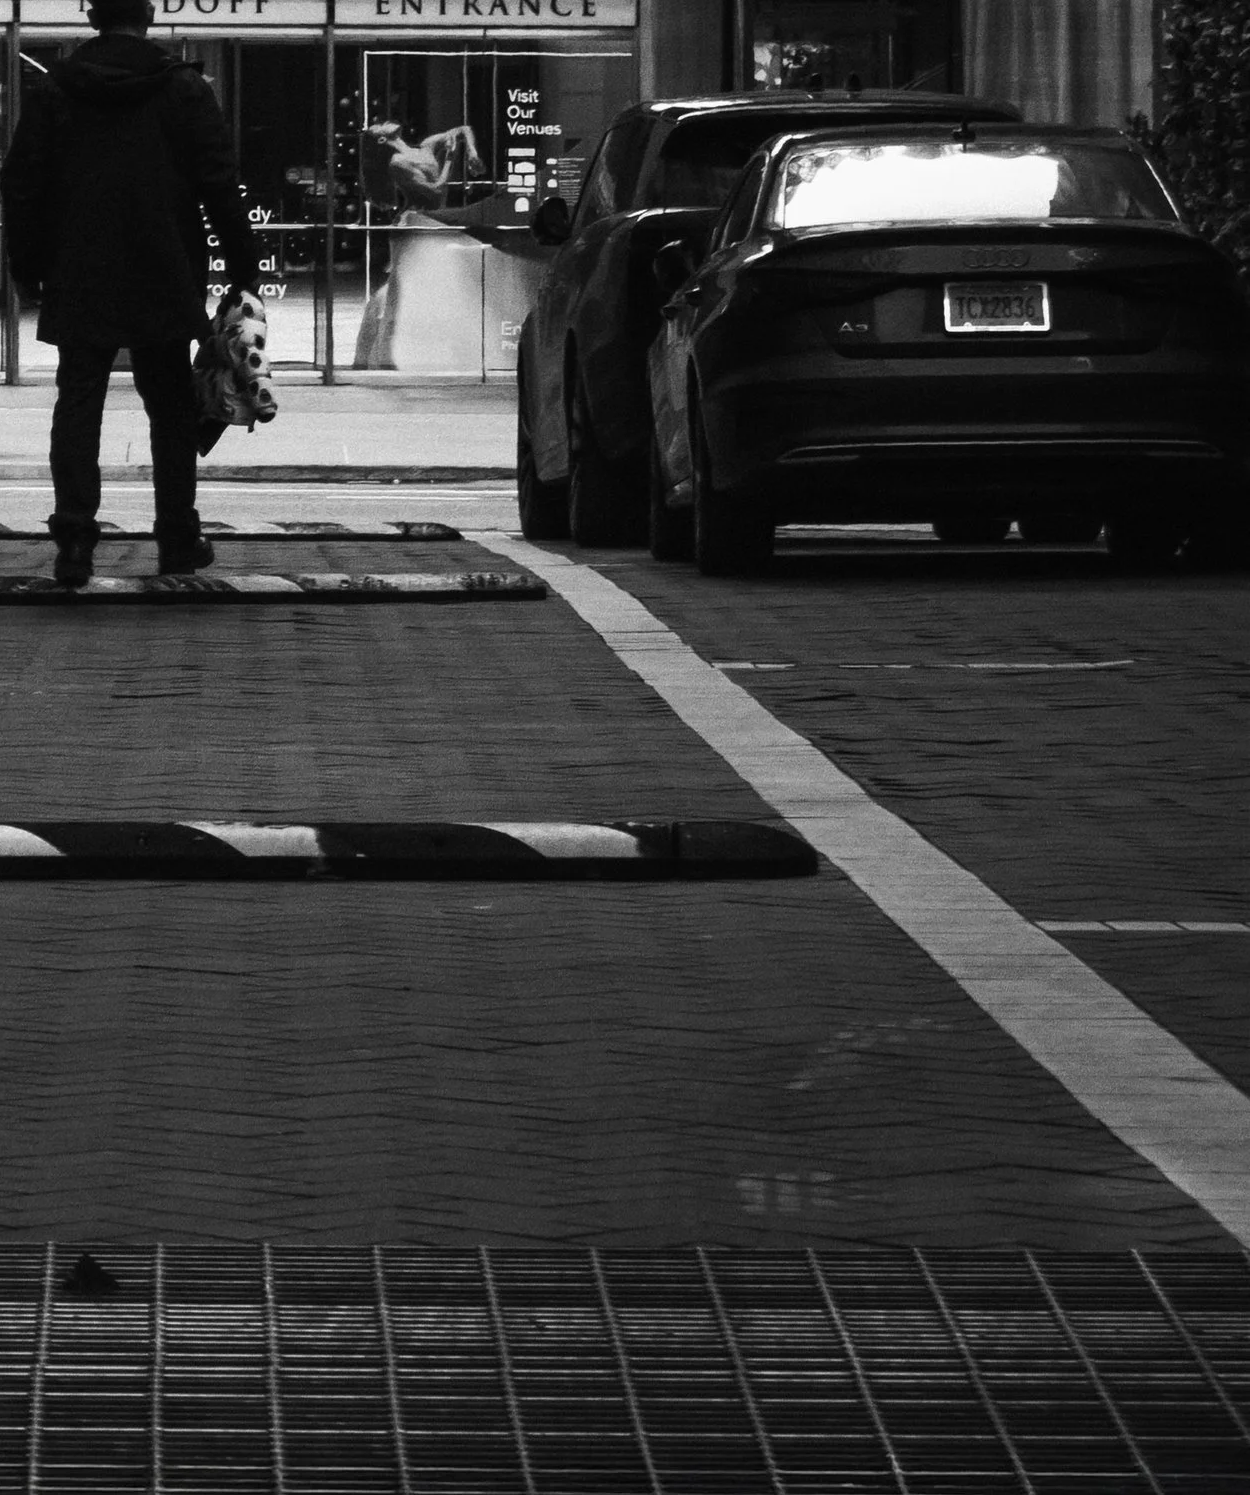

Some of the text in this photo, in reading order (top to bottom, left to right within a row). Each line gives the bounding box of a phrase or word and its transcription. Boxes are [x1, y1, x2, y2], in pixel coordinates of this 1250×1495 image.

[506, 88, 540, 103] Visit
[506, 105, 536, 119] Our
[506, 121, 563, 136] Venues
